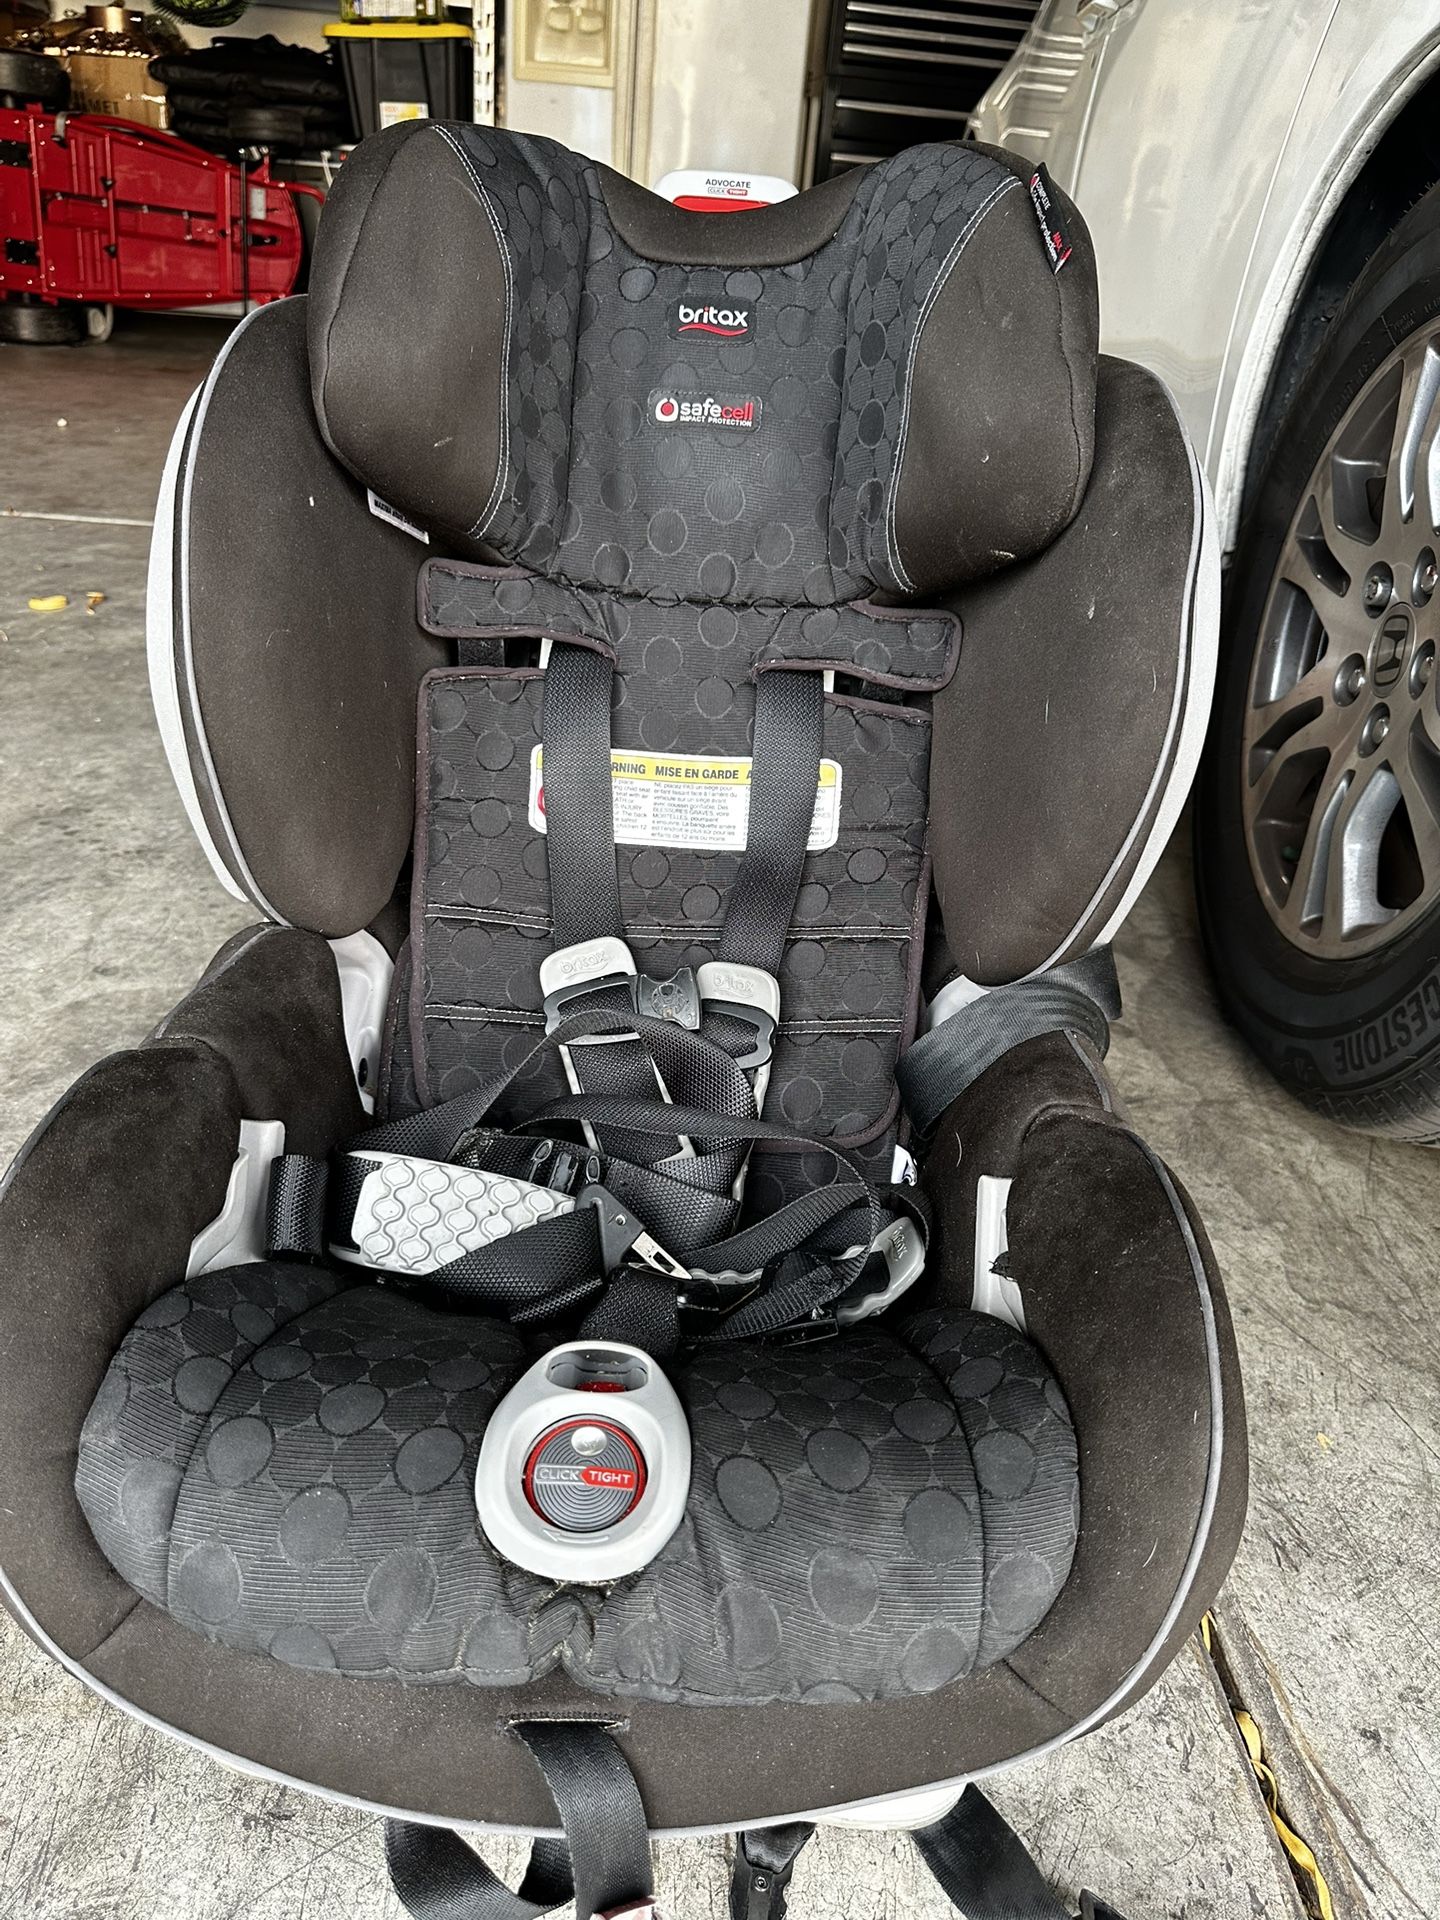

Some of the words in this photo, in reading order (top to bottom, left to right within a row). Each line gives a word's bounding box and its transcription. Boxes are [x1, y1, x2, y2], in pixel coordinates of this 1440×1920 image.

[705, 178, 751, 188] ADVOCATE
[1036, 181, 1051, 211] COMPLETE
[679, 305, 748, 327] britax
[680, 398, 754, 420] safecell
[680, 415, 706, 423] IMPACT
[708, 417, 753, 427] PROTECTION
[611, 762, 646, 775] RNING
[655, 765, 682, 777] MISE
[684, 767, 699, 778] EN
[702, 768, 739, 780] GARDE
[559, 951, 609, 974] britax
[1333, 975, 1440, 1075] GESTONE
[539, 1468, 580, 1481] CLICK
[588, 1470, 631, 1484] TIGHT
